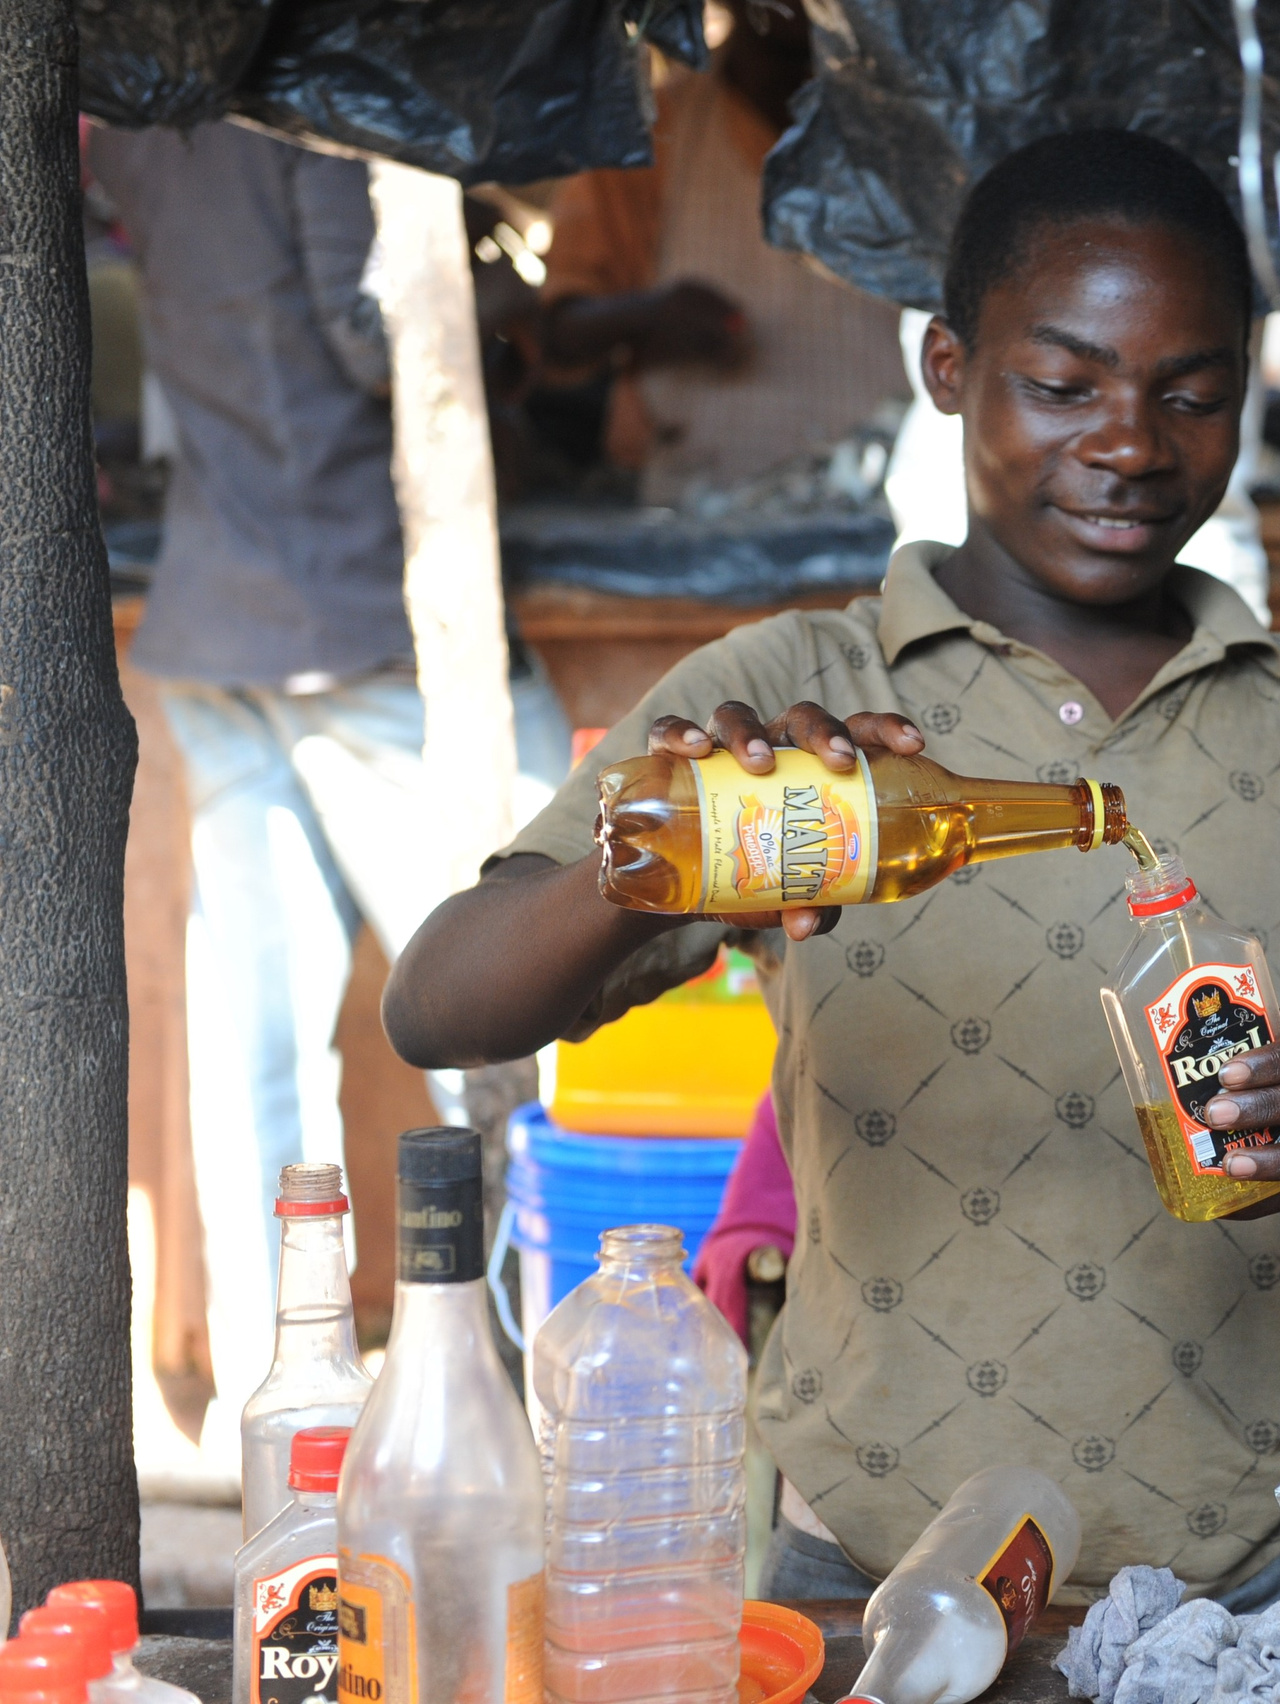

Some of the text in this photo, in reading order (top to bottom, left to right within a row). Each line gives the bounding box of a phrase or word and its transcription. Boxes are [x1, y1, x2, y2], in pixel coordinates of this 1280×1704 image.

[742, 822, 766, 877] Pineapple
[759, 832, 777, 855] 0%
[781, 785, 829, 902] MALTI
[1200, 1018, 1229, 1037] Original
[1205, 1013, 1220, 1026] The
[315, 1611, 336, 1622] The
